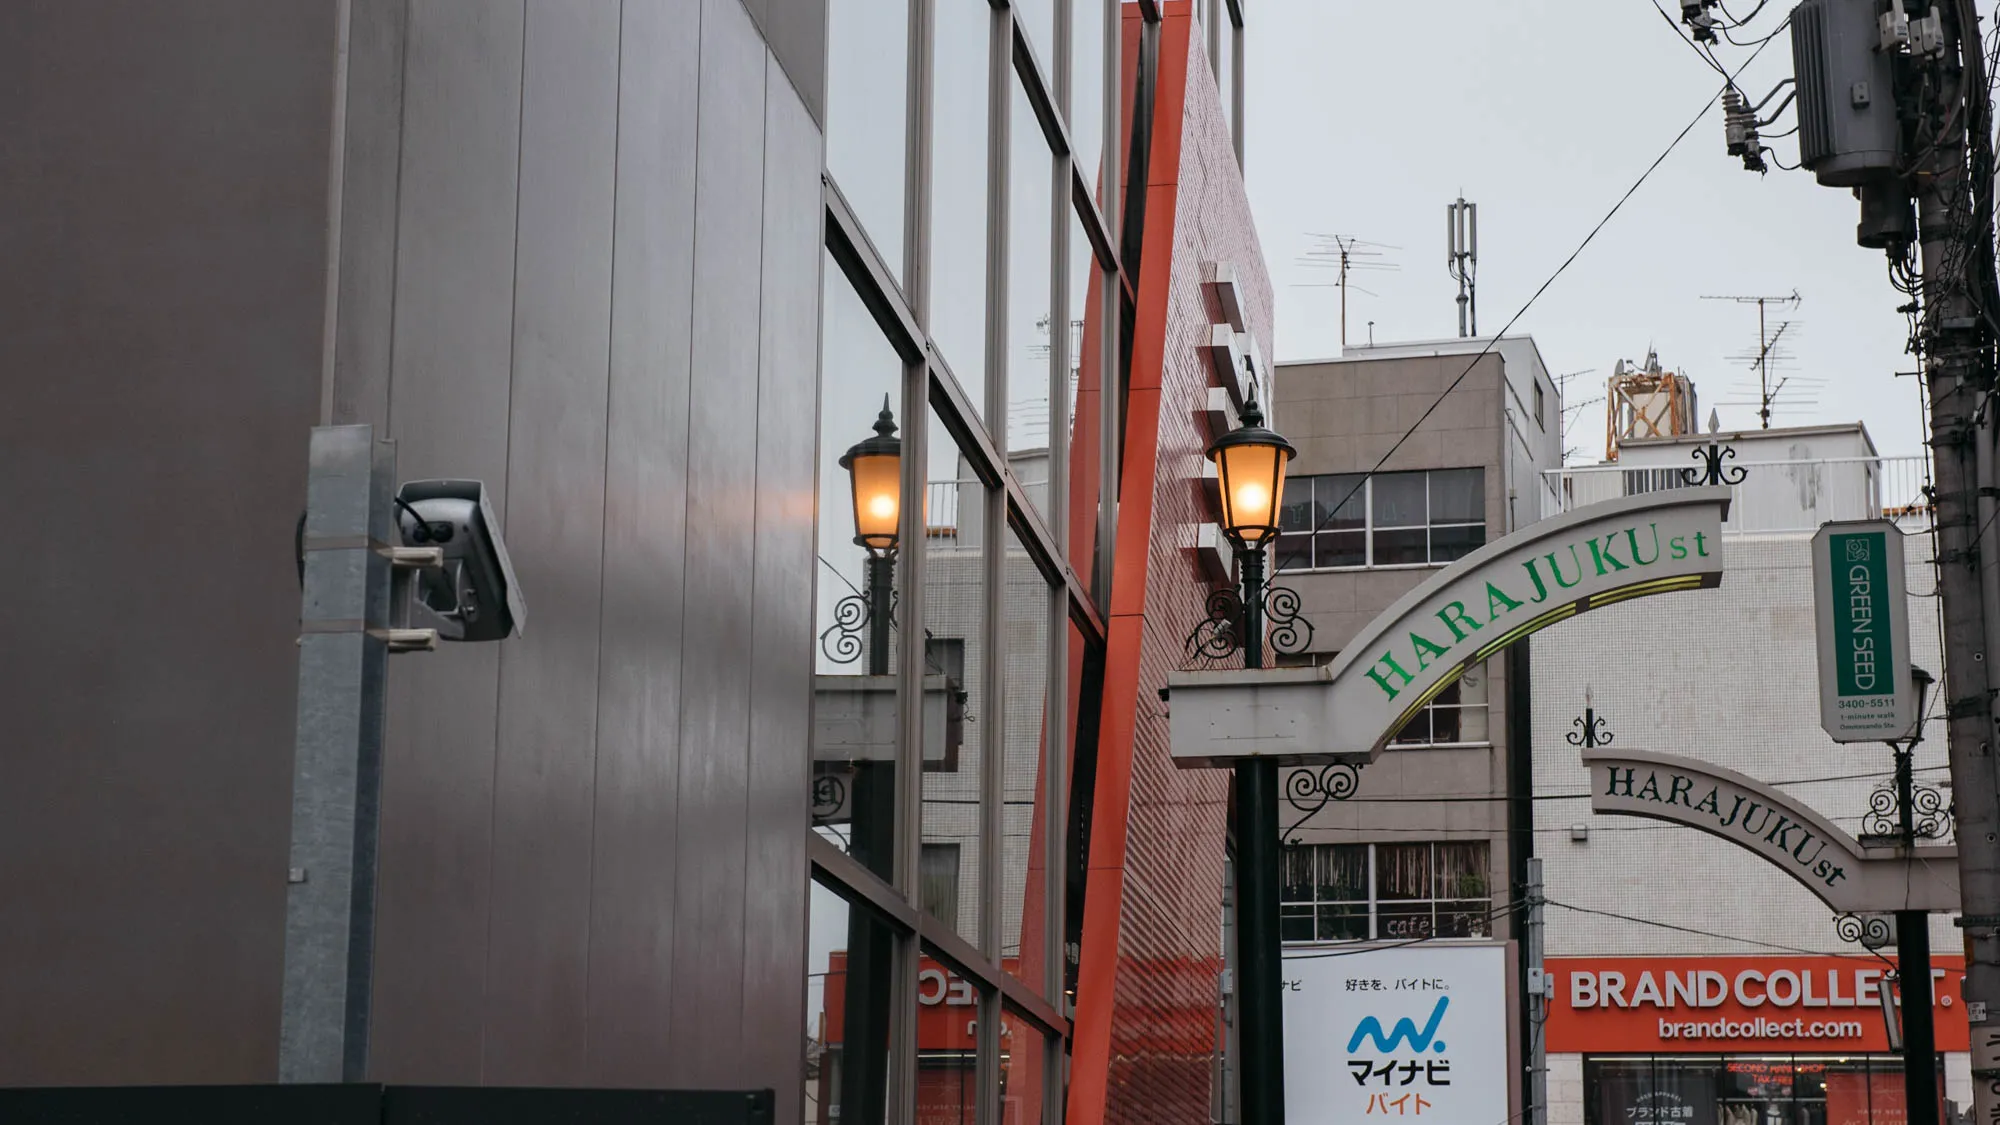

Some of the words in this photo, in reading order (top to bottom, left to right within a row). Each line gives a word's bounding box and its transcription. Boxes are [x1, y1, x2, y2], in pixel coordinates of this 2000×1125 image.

[1849, 565, 1873, 633] GREEN
[1852, 636, 1876, 690] SEED
[1838, 698, 1896, 709] 3400-5511
[1345, 978, 1450, 991] 好きを、バイトに。
[1570, 970, 1729, 1007] BRAND
[1659, 1017, 1862, 1038] brandcollect.com
[1347, 1060, 1450, 1086] マイナビ
[1727, 1063, 1767, 1073] SECOND
[1366, 1092, 1432, 1115] バイト
